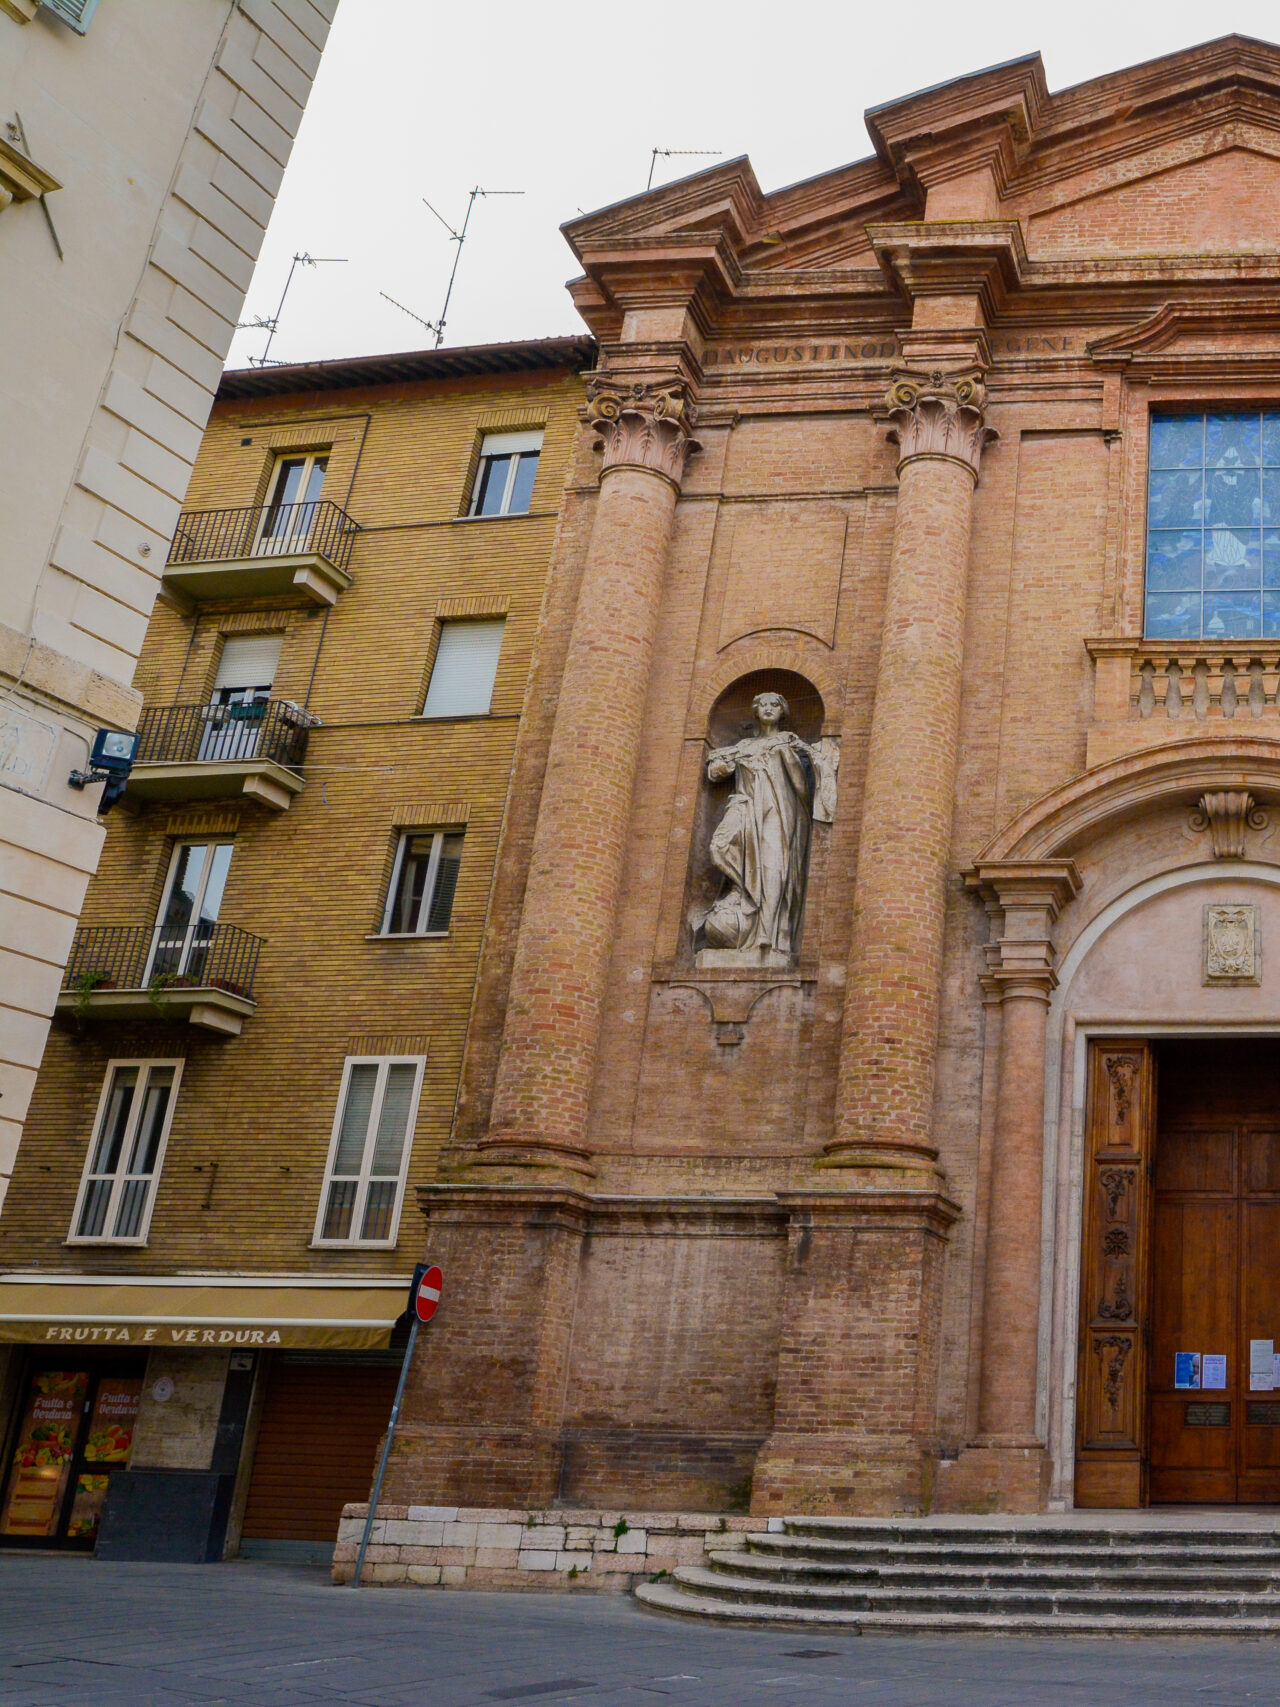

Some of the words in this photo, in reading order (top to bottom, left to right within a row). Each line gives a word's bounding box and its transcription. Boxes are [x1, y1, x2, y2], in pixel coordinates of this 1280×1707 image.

[46, 1327, 130, 1341] FRUTTA
[143, 1328, 158, 1342] E
[171, 1328, 281, 1344] VERDURA
